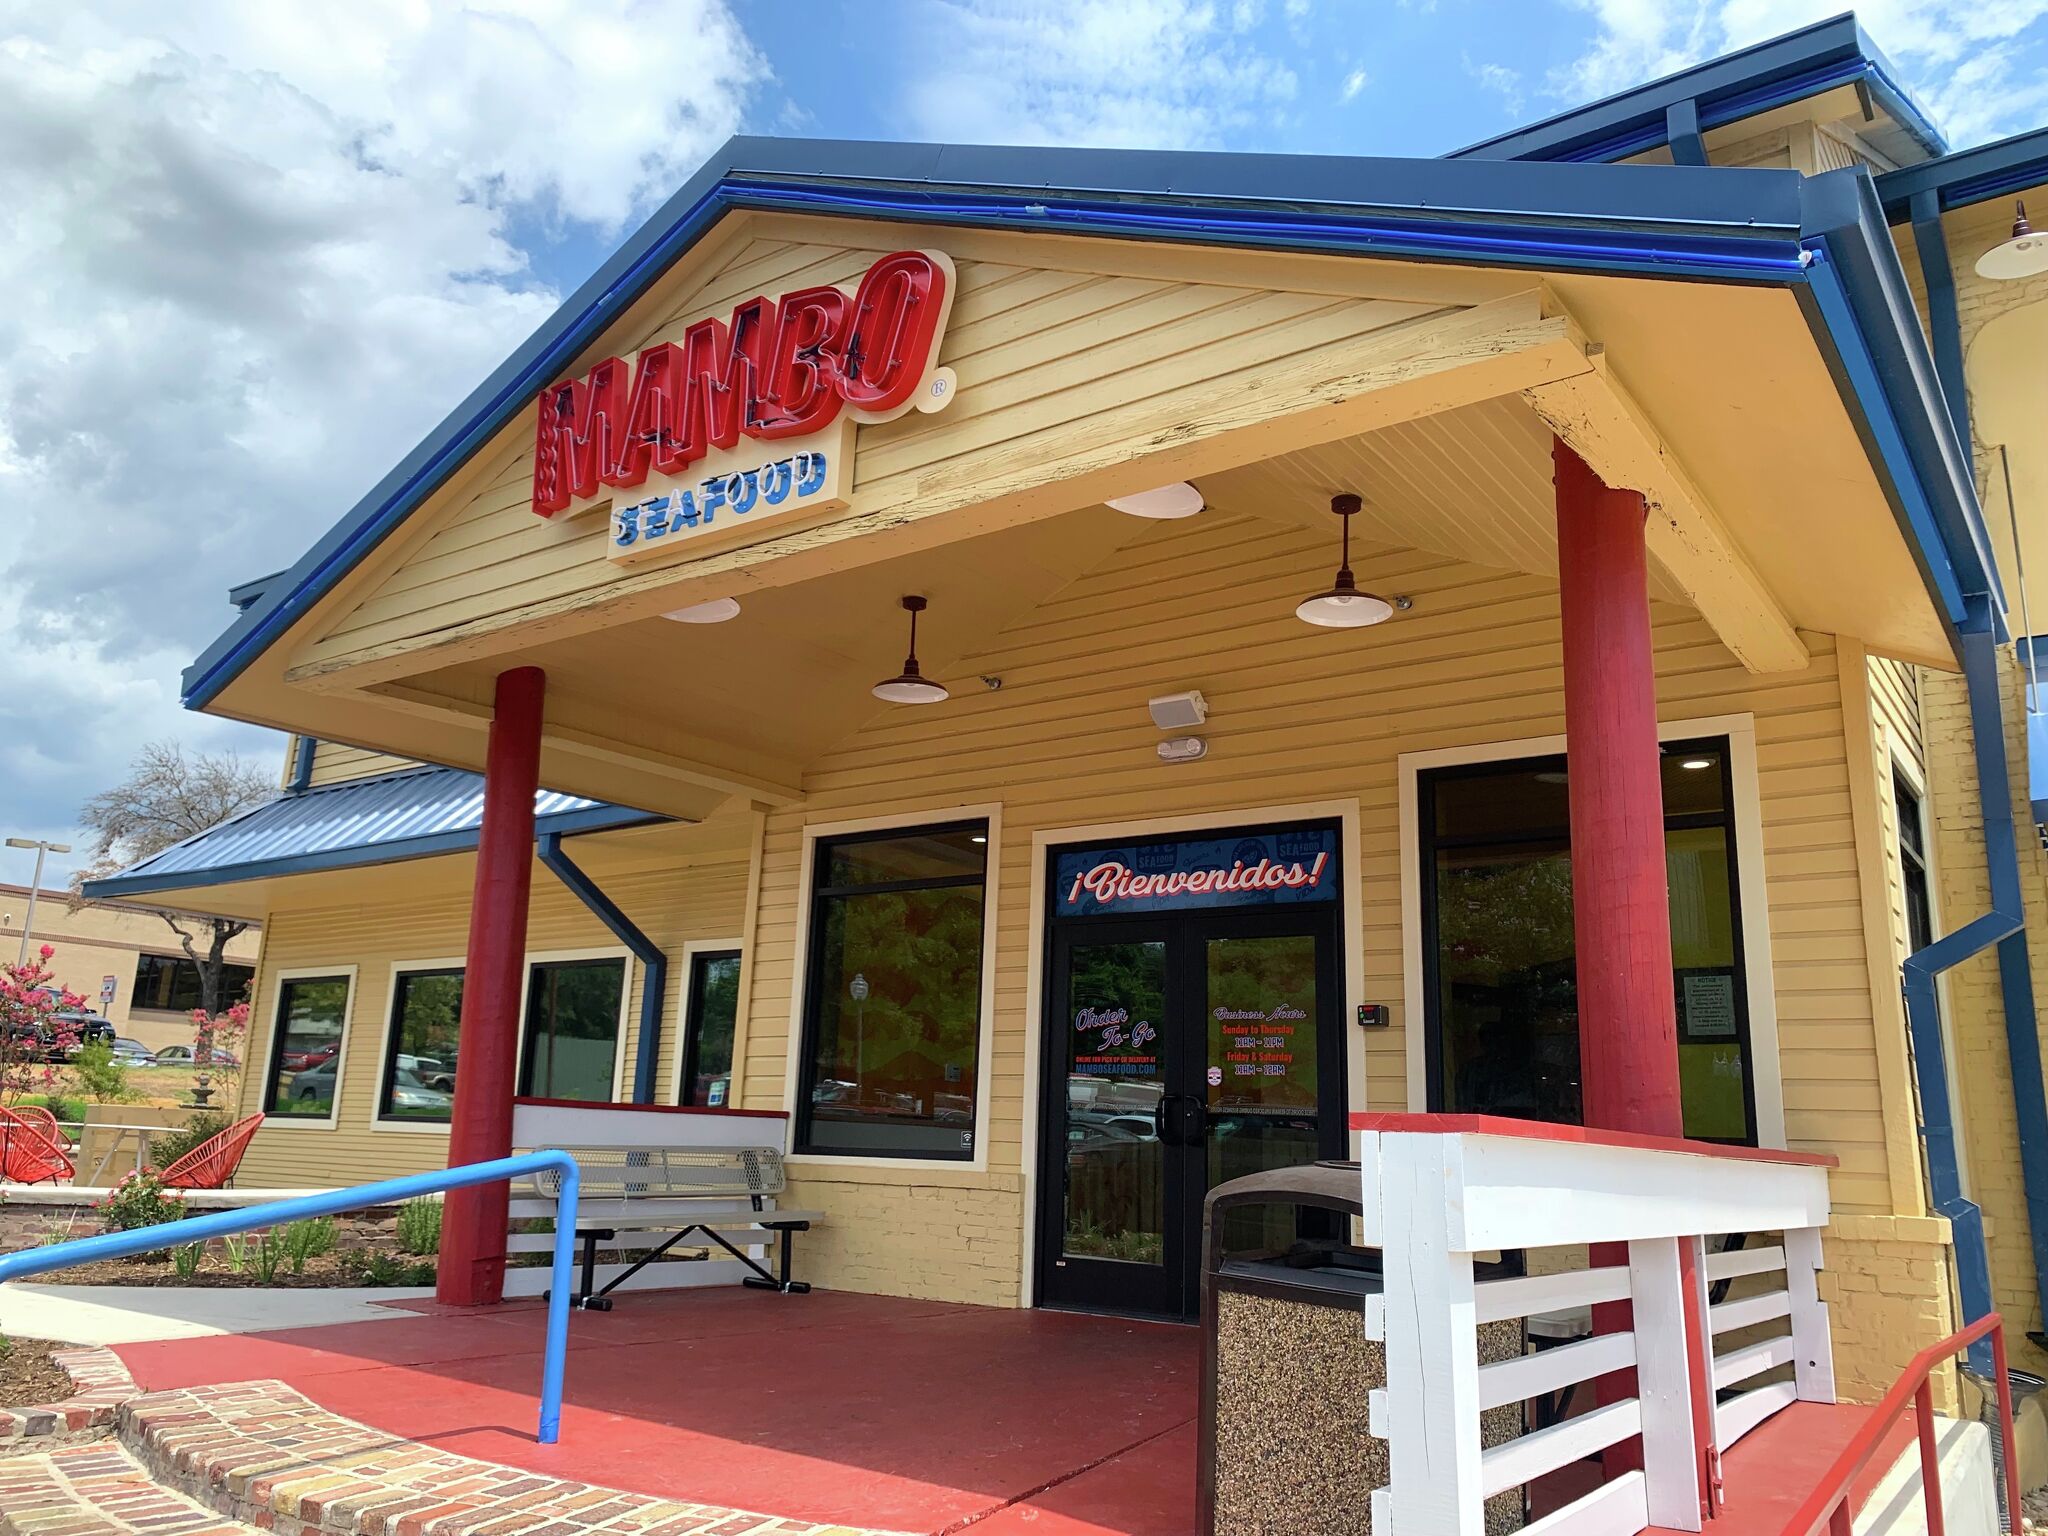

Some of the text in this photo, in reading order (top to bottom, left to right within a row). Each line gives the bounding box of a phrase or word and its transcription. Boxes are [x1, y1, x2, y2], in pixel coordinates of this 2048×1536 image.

[531, 250, 946, 518] MAMBO
[612, 451, 827, 547] SEAFOOD
[1138, 854, 1174, 869] SEAFOOD
[1067, 851, 1329, 904] ¡Bienvenidos!
[1075, 1007, 1129, 1031] Order
[1213, 1003, 1307, 1021] Business Hours
[1222, 1024, 1294, 1035] Sunday to Thursday
[1226, 1051, 1293, 1063] Friday & Saturday
[1075, 1064, 1156, 1074] MAMBOSEAFOOD.COM
[1263, 1064, 1286, 1076] 12AM
